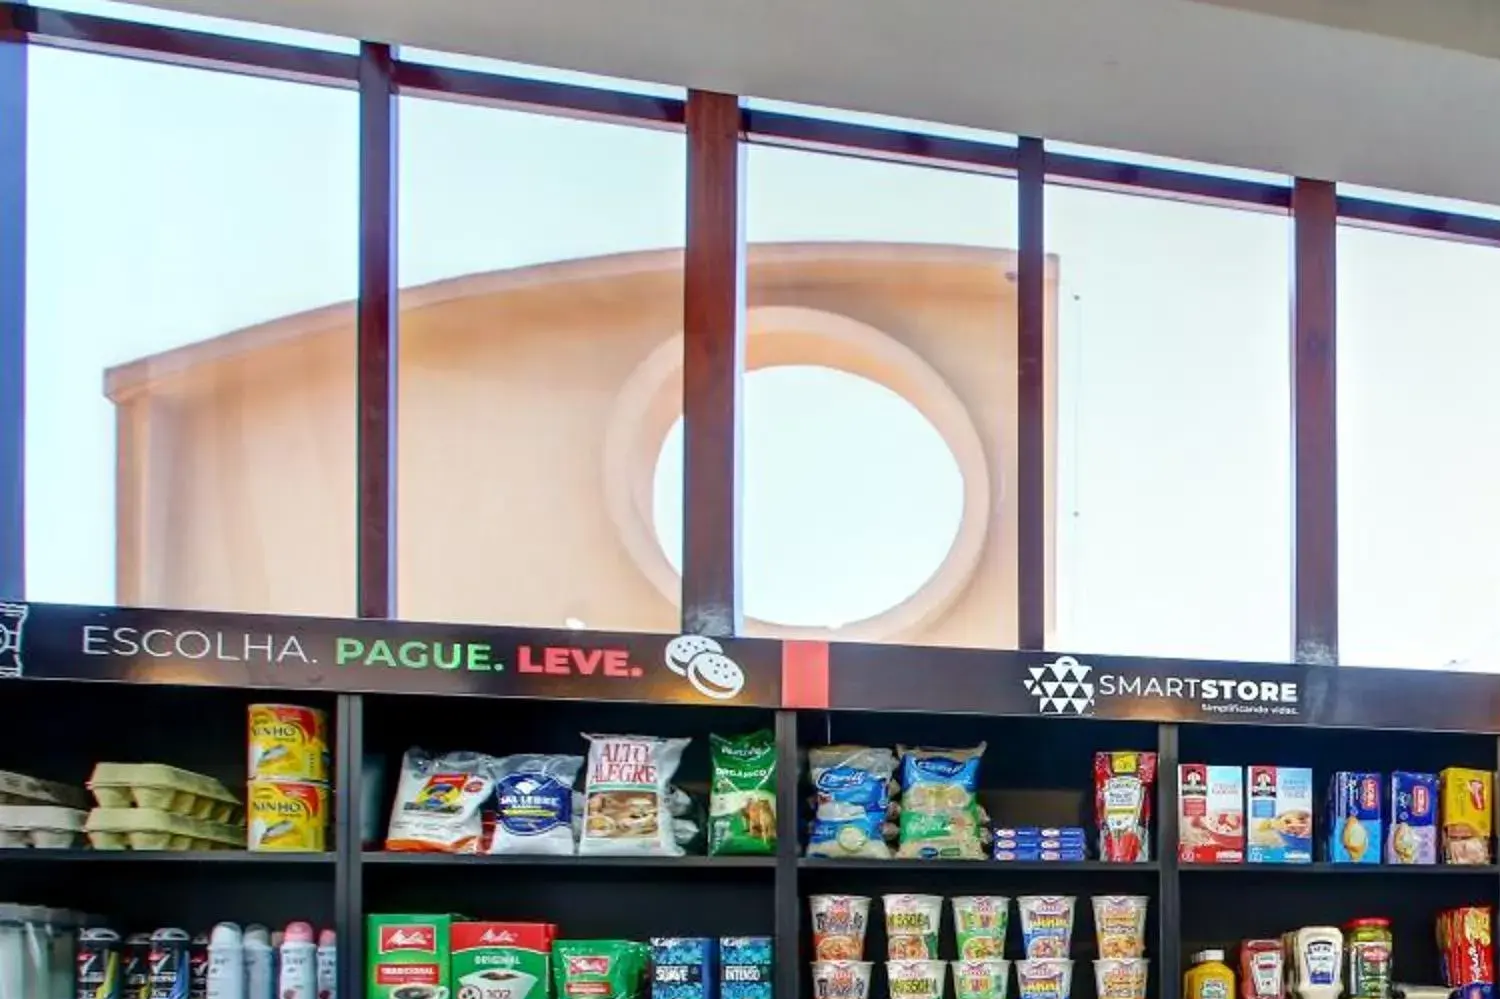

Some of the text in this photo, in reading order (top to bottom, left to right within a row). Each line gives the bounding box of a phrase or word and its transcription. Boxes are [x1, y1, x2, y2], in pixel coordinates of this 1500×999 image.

[81, 624, 643, 678] ESCOLHA. PAGUE. LEVE.
[1099, 673, 1298, 703] SMARTSTORE
[600, 744, 649, 764] ALTO
